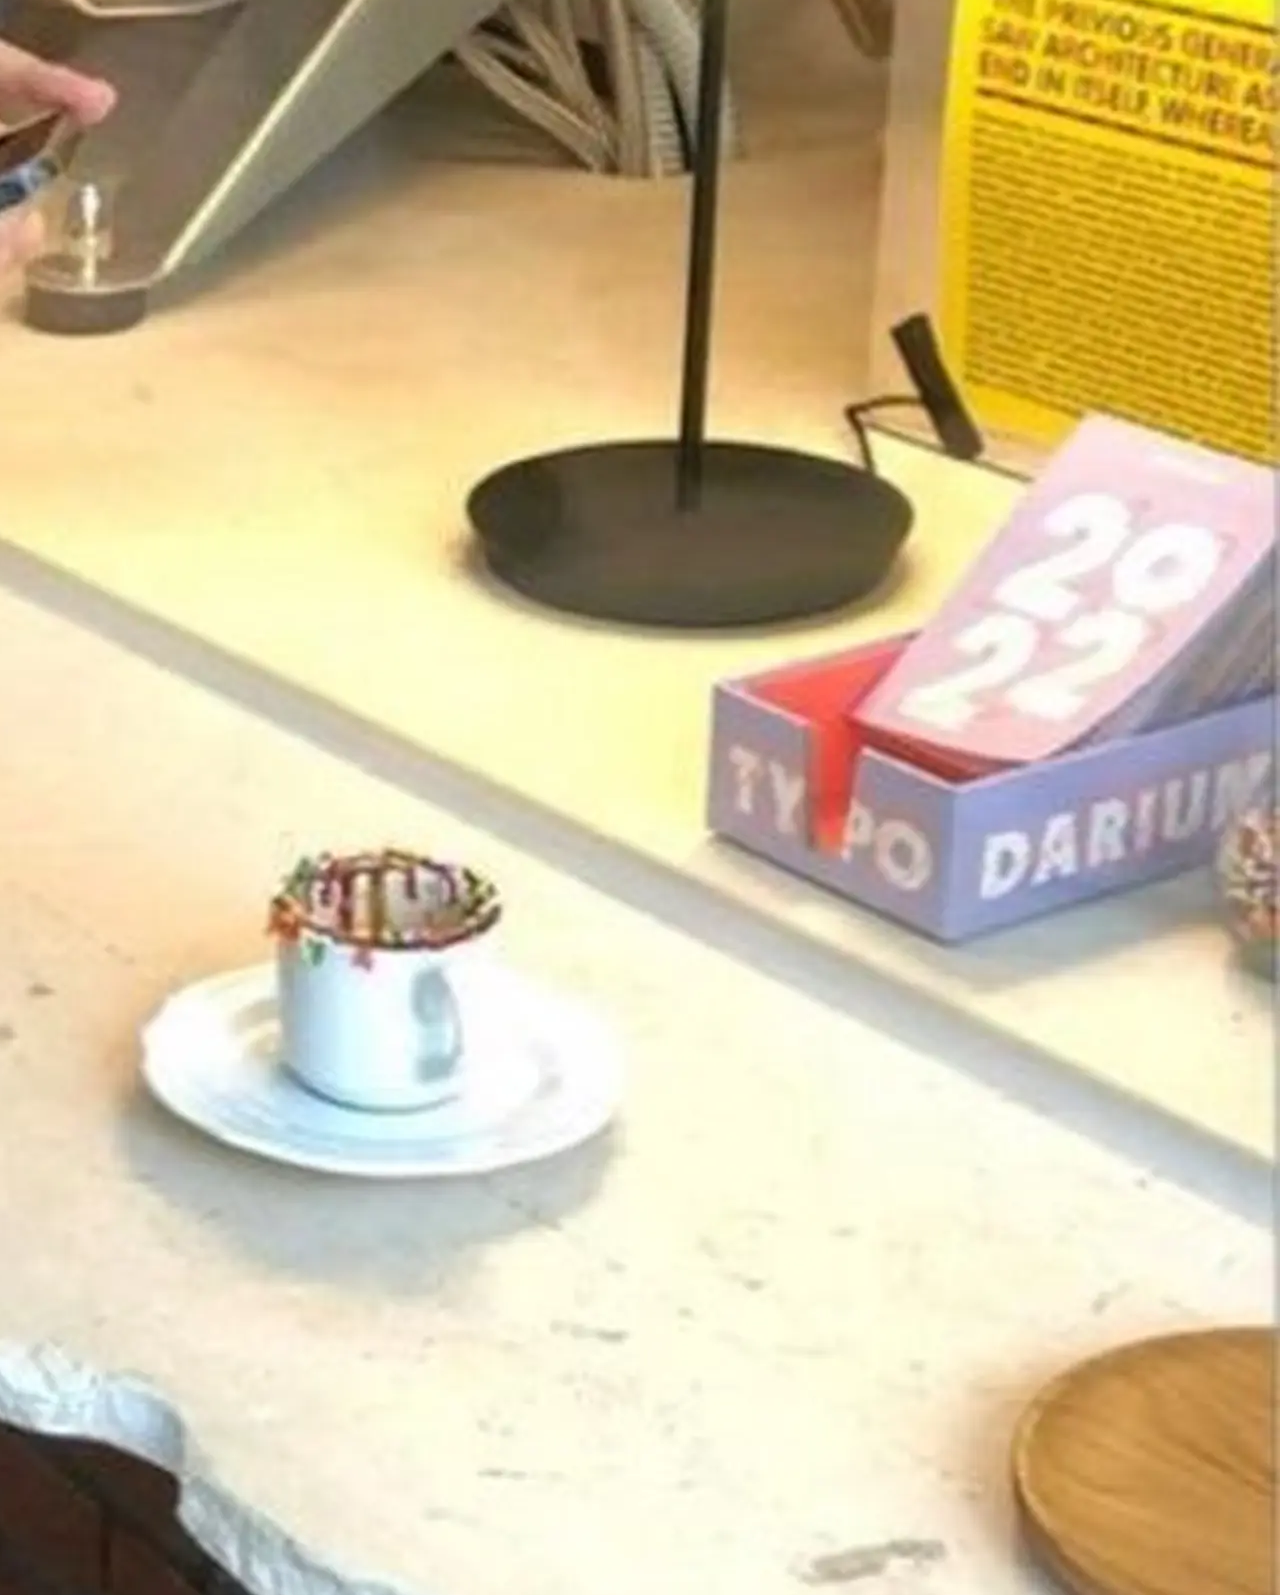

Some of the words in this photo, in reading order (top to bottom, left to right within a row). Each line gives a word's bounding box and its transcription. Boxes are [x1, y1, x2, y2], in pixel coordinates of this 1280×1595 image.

[977, 50, 1030, 87] END
[1037, 64, 1066, 95] IN
[1042, 33, 1237, 102] ARCHITECTURE
[993, 492, 1224, 620] 20
[898, 609, 1149, 729] 22
